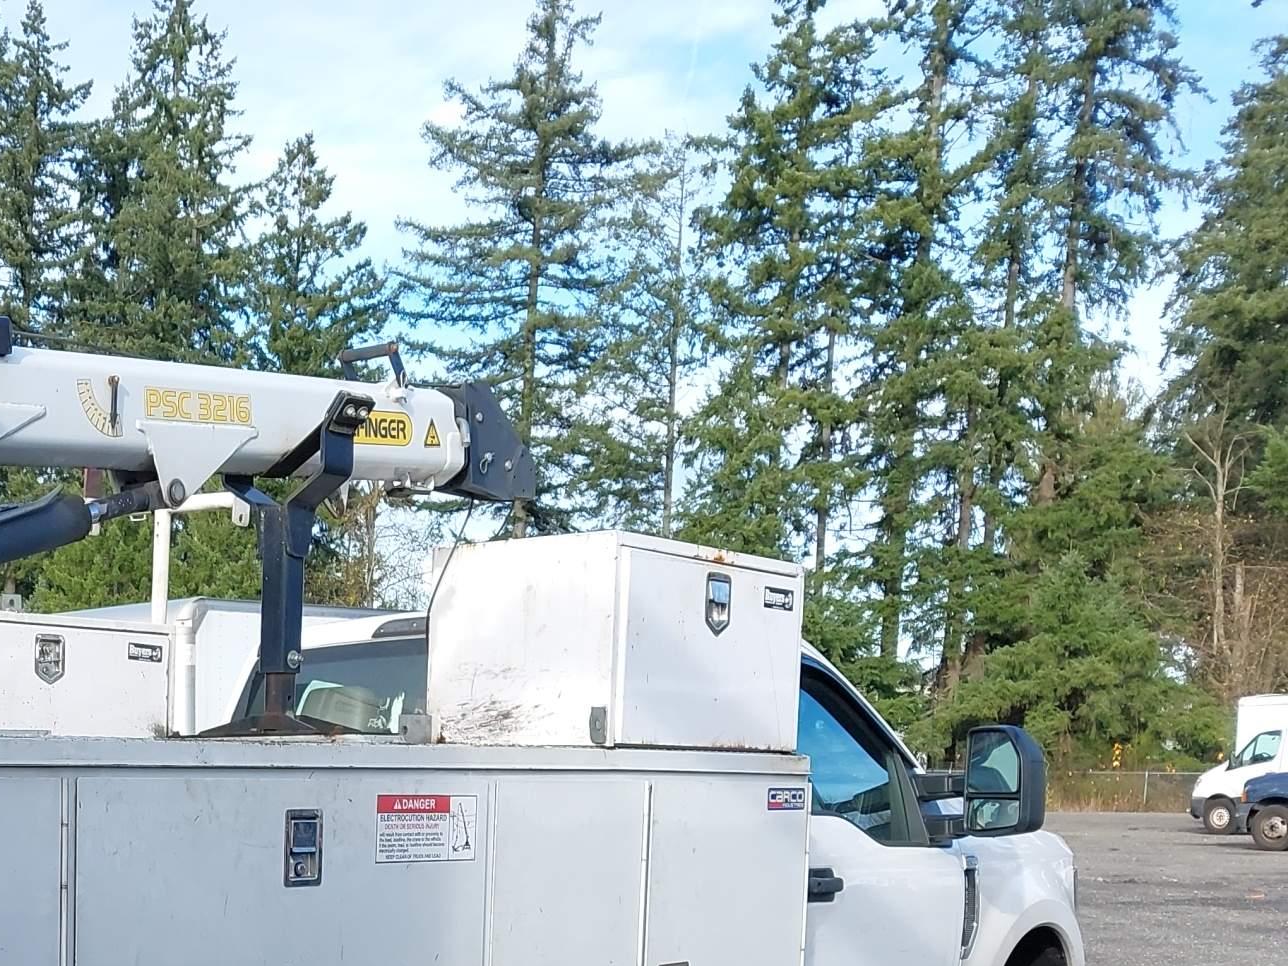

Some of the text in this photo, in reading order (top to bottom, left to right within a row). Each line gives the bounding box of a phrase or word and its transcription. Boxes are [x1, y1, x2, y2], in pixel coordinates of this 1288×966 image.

[145, 388, 251, 423] PSC 3216
[402, 799, 436, 810] DANGER
[380, 814, 448, 823] ELECTROCUTION HAZARD
